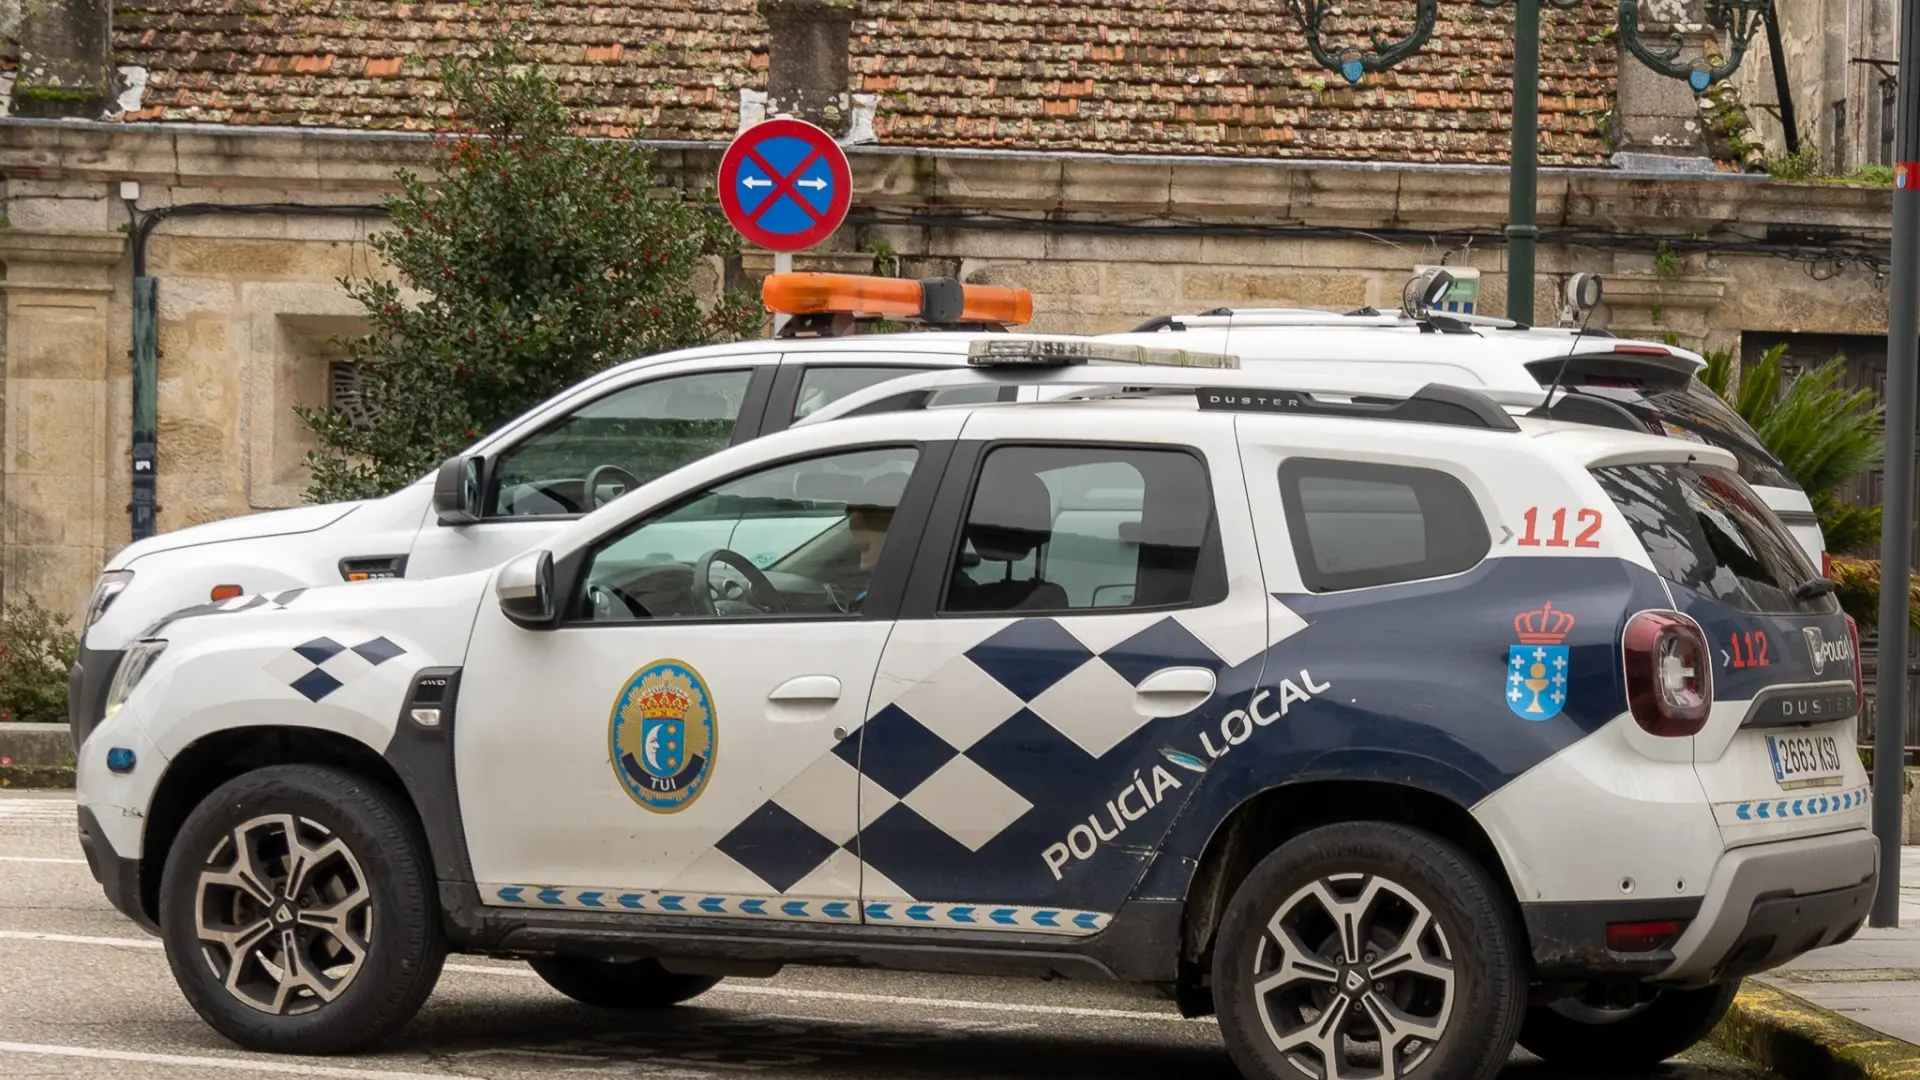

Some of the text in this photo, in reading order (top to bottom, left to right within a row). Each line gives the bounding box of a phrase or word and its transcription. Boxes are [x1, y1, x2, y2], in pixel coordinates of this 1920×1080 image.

[1210, 395, 1299, 407] DUSTER
[1517, 506, 1603, 549] 112
[1730, 631, 1770, 668] 112
[1782, 696, 1854, 716] DUSTER
[1779, 736, 1841, 774] 2663 KSD
[650, 776, 677, 791] TUI
[1041, 668, 1331, 881] POLICÍA LOCAL
